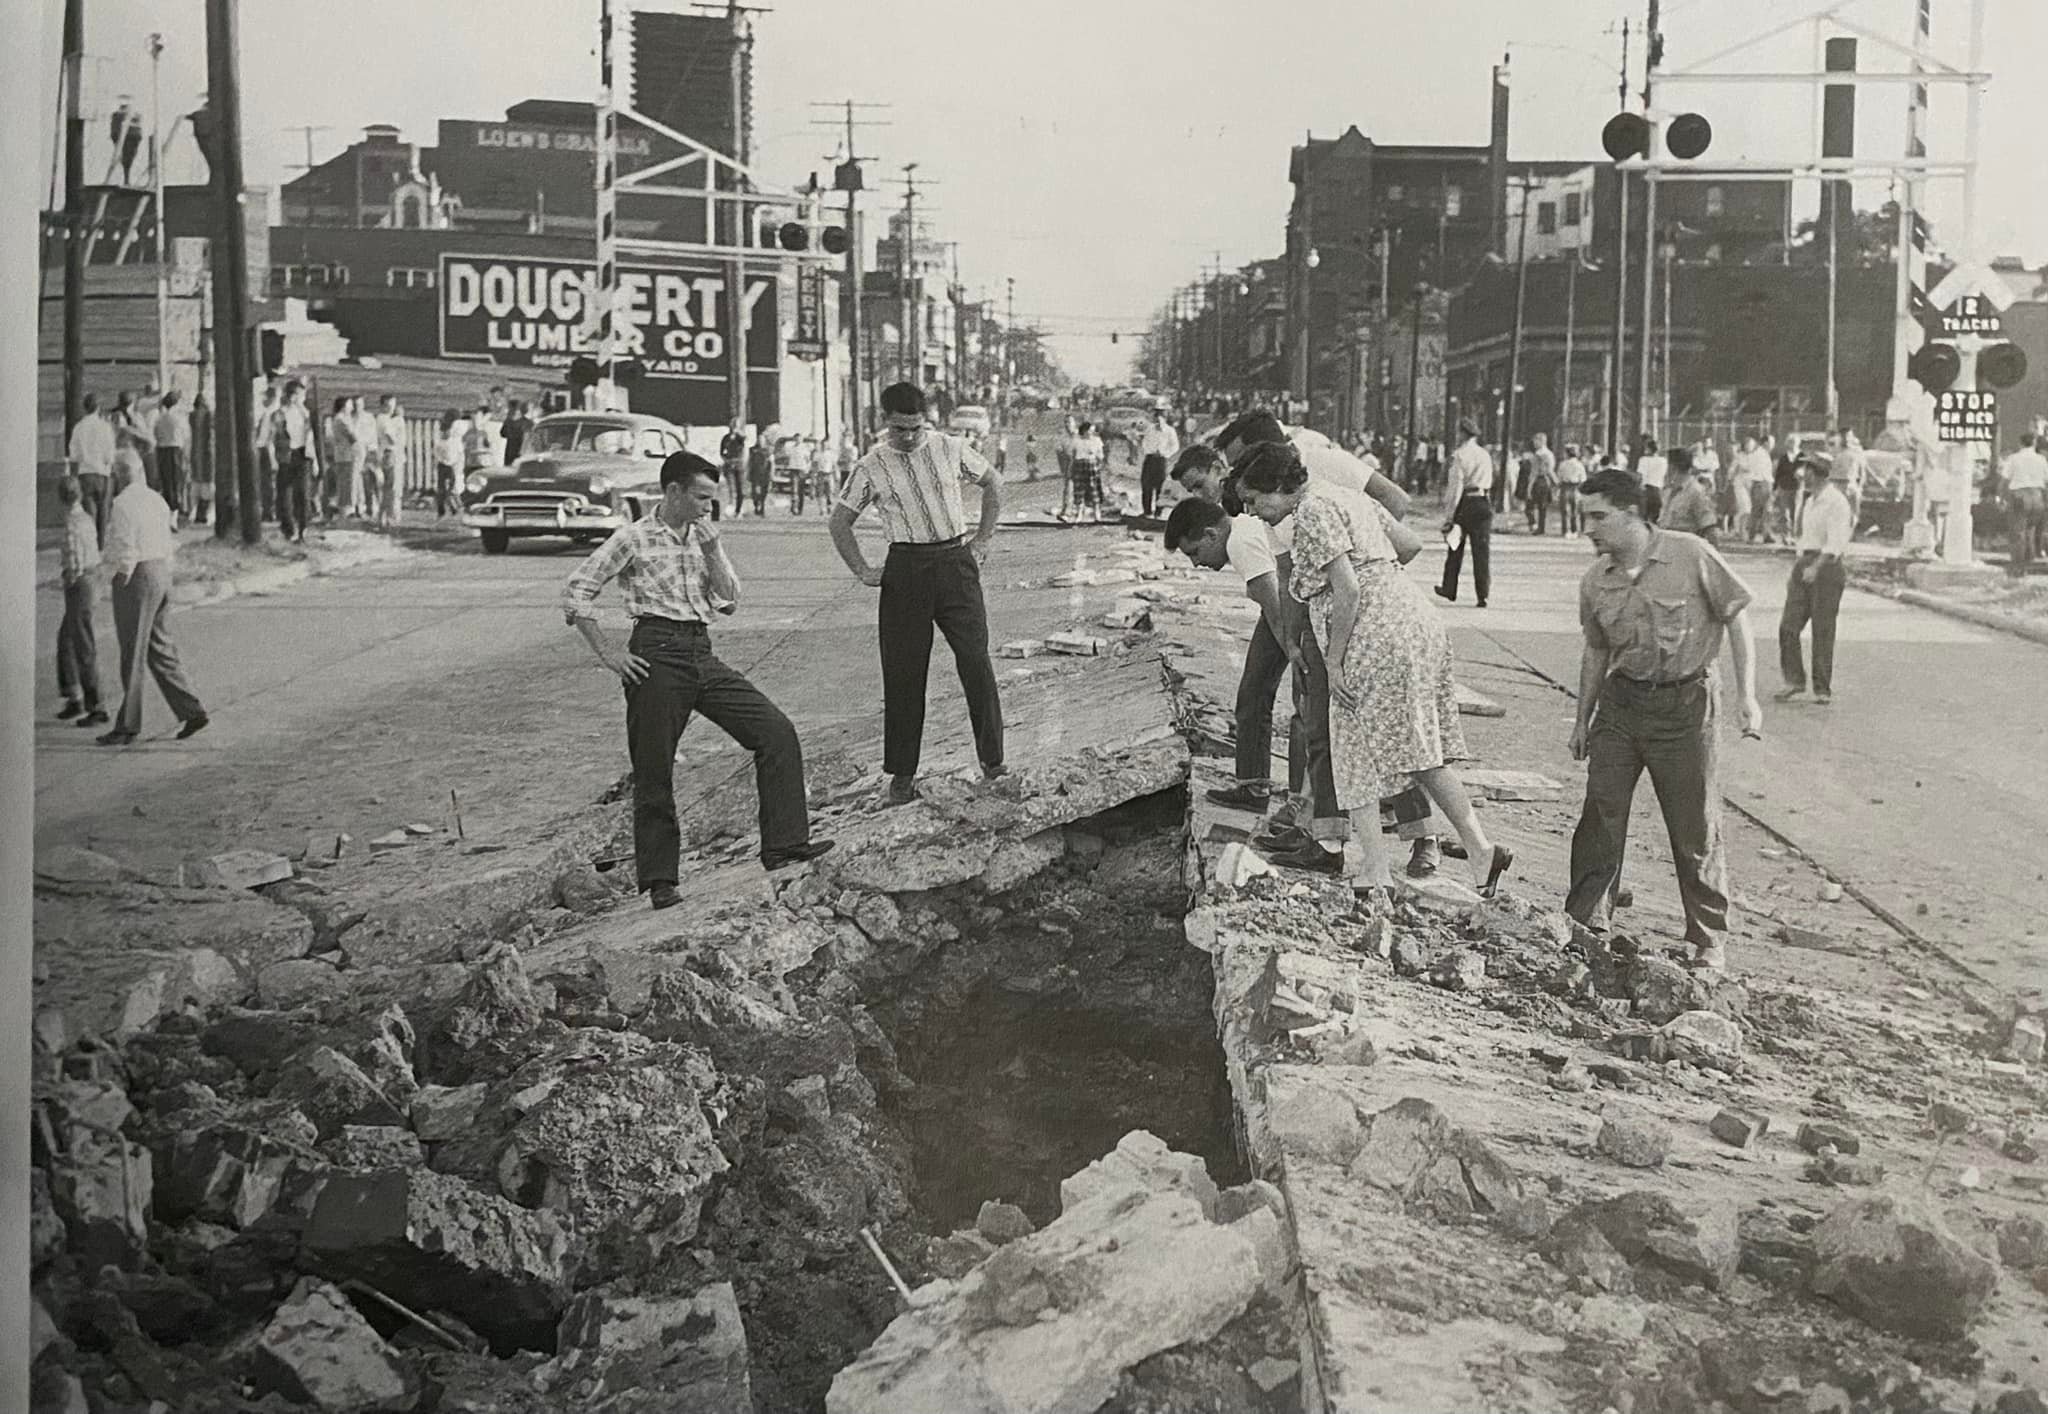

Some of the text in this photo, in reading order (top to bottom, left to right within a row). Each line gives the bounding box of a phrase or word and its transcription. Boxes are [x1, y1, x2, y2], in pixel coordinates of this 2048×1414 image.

[1942, 317, 2000, 331] TRACKS
[663, 330, 723, 358] CO
[642, 359, 698, 373] YARD
[1941, 392, 1995, 410] STOP
[1940, 411, 1994, 424] ON RED
[1940, 426, 1993, 439] SIGNAL
